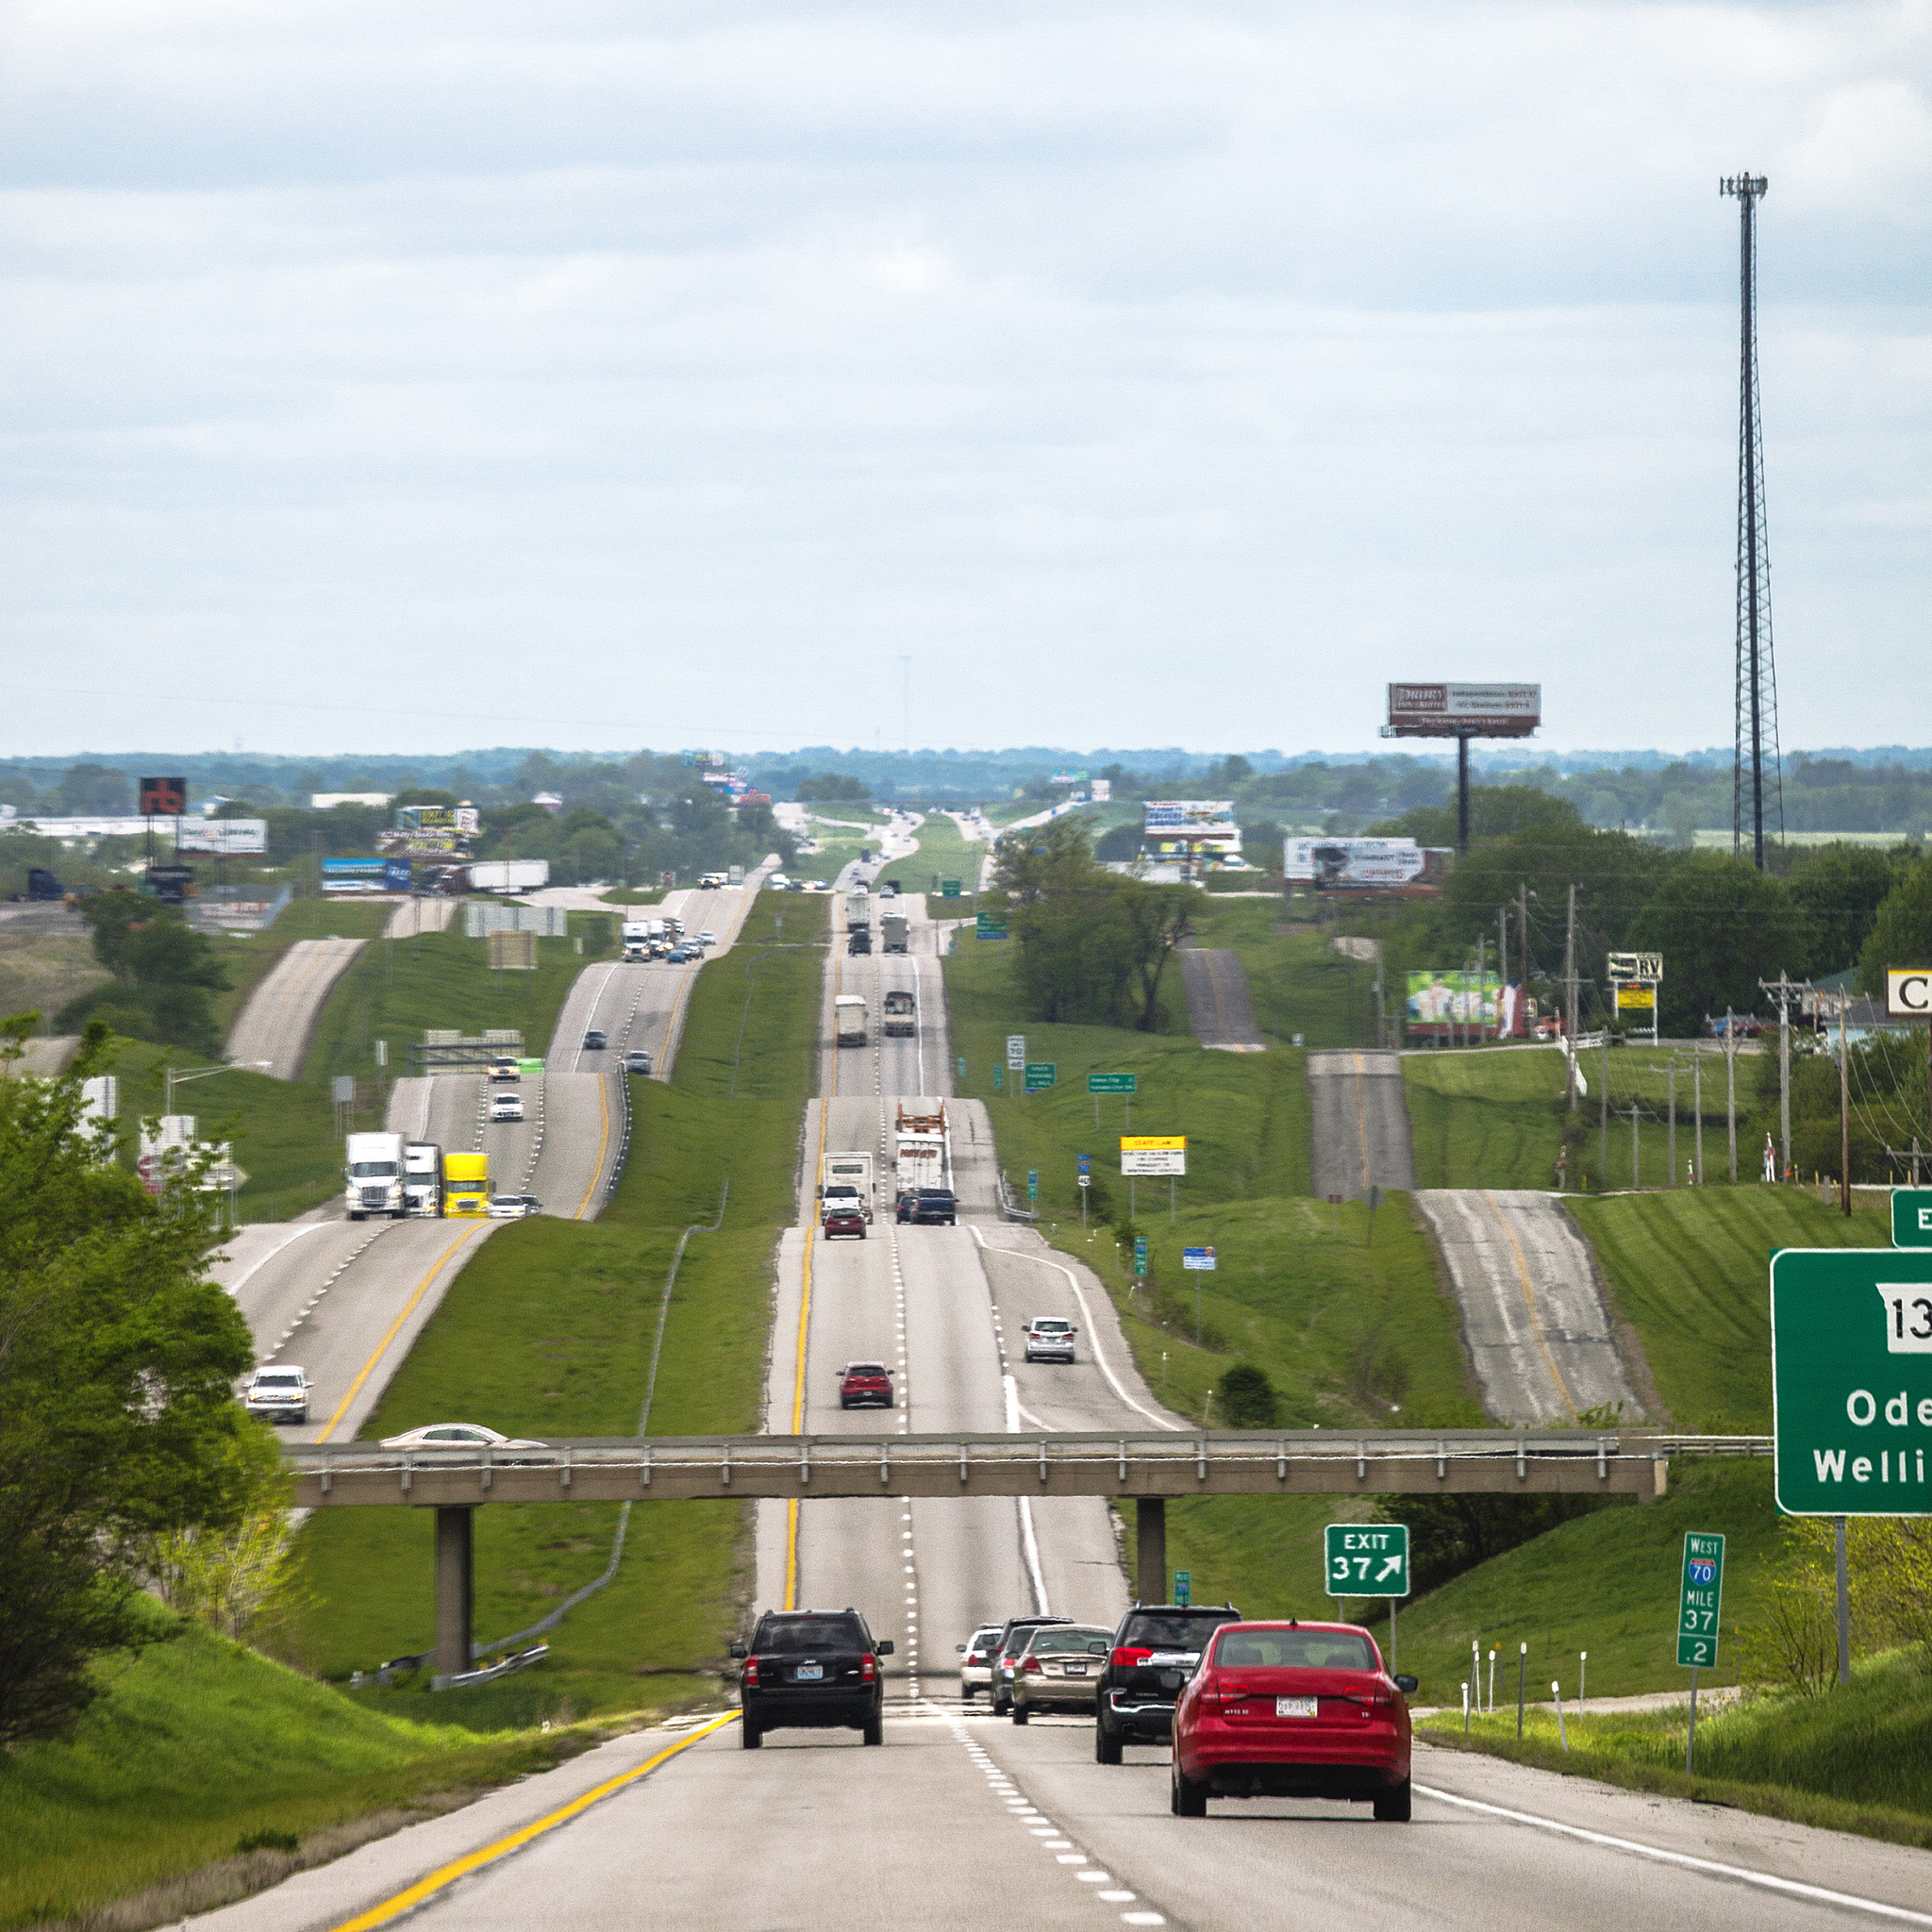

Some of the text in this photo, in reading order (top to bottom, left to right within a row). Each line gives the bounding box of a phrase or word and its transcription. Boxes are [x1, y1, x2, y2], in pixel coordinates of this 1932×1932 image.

[1640, 958, 1659, 974] RV
[1898, 976, 1928, 1009] C
[1813, 1449, 1925, 1483] Welli
[1344, 1534, 1390, 1550] EXIT
[1690, 1538, 1719, 1555] WEST
[1332, 1556, 1372, 1581] 37
[1692, 1565, 1711, 1582] 70
[1687, 1590, 1714, 1607] MILE
[1684, 1609, 1714, 1632] 37
[1686, 1642, 1707, 1662] .2
